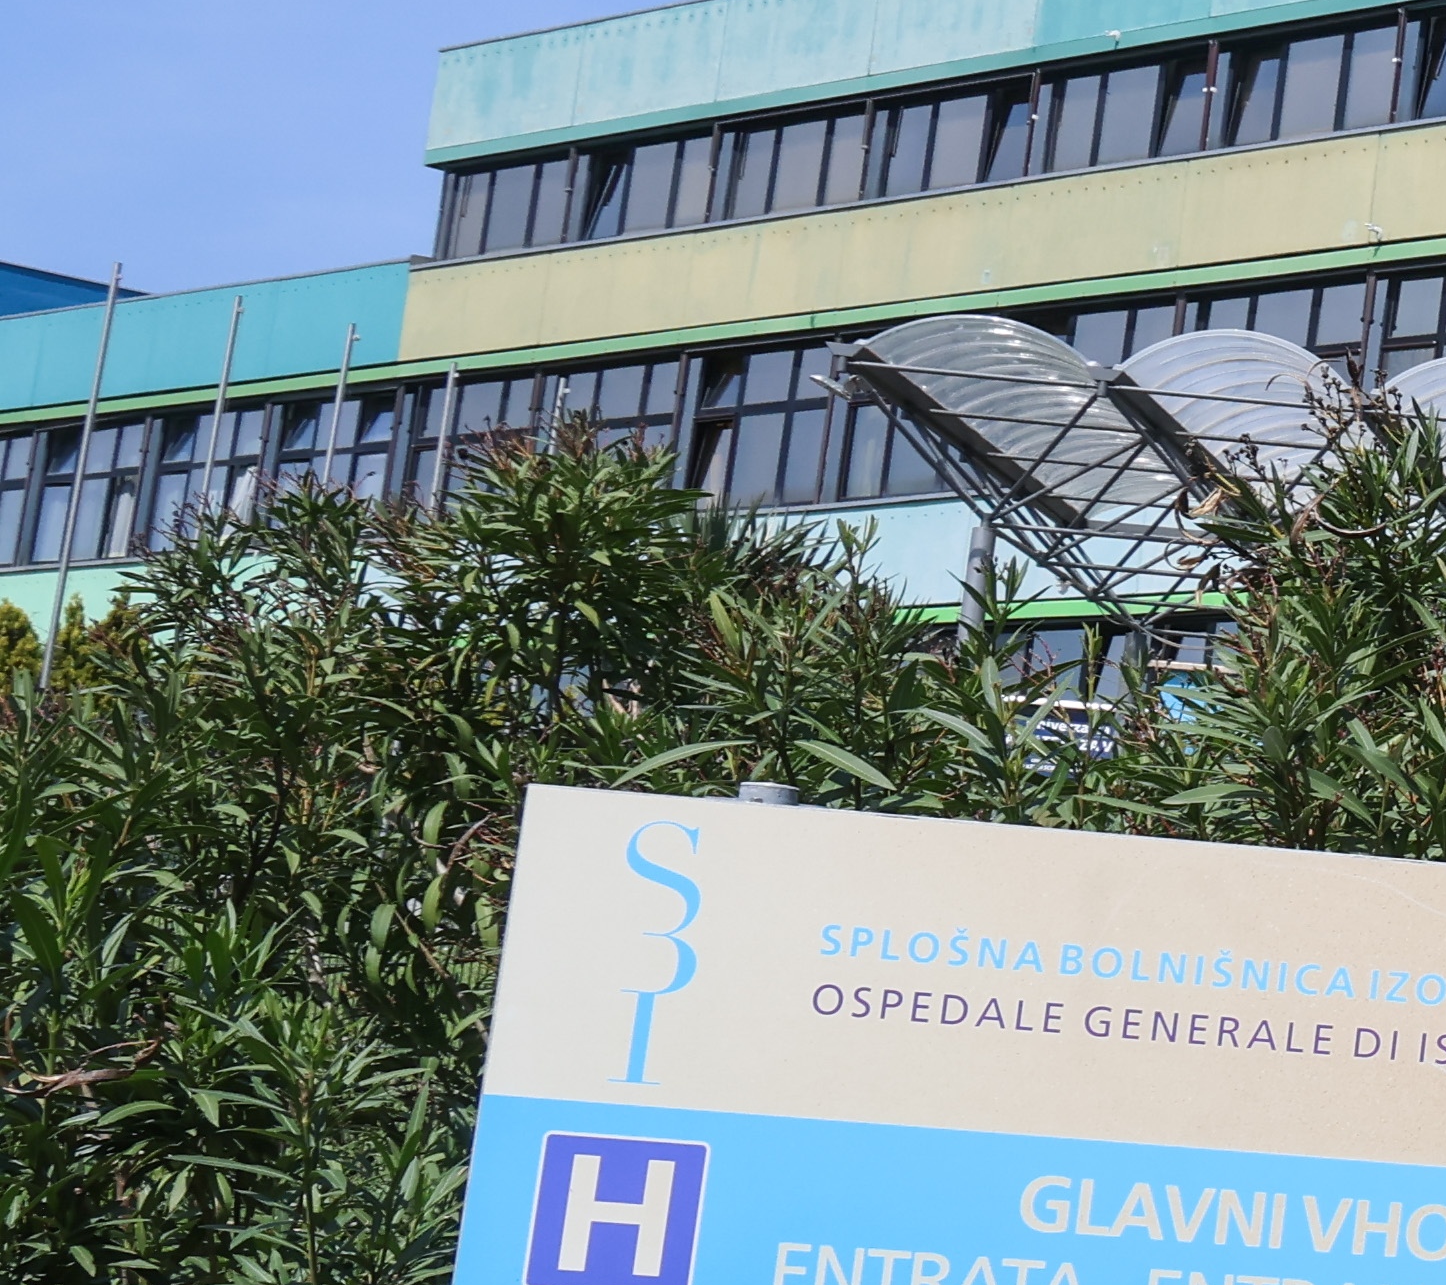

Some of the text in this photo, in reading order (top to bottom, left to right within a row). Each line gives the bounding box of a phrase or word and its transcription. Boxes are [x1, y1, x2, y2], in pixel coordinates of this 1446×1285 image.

[820, 924, 1044, 973] SPLOŠNA
[1058, 943, 1355, 998] BOLNIŠNICA
[812, 983, 1064, 1034] OSPEDALE
[1084, 1006, 1334, 1055] GENERALE
[1353, 1027, 1399, 1061] DI
[557, 1153, 677, 1278] H
[1020, 1175, 1288, 1249] GLAVNI
